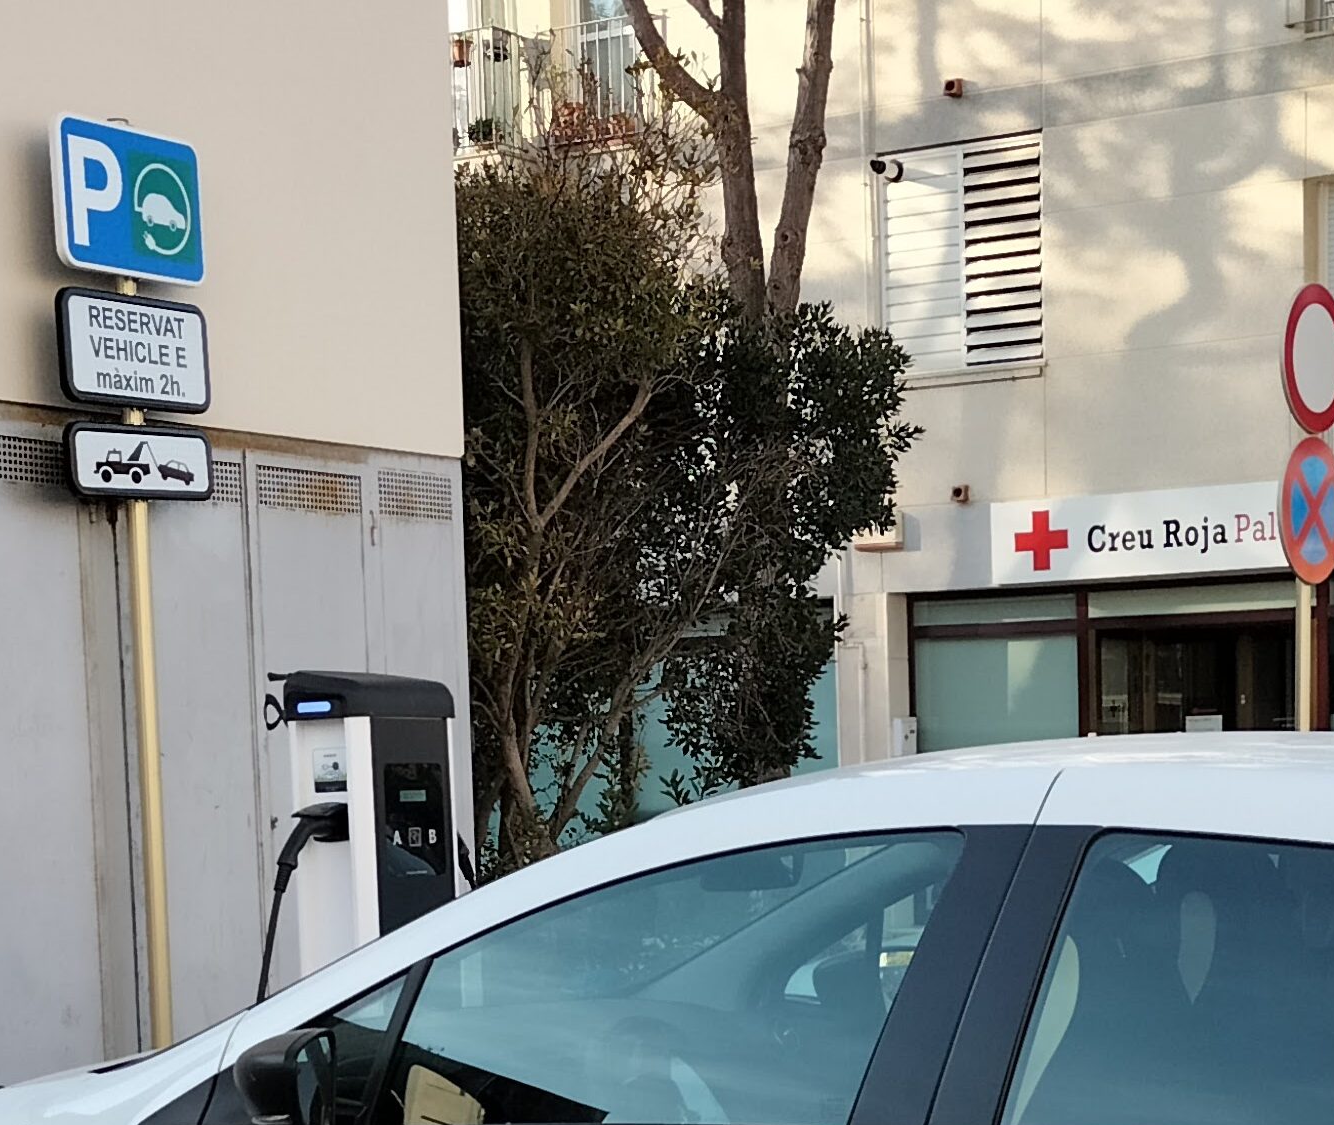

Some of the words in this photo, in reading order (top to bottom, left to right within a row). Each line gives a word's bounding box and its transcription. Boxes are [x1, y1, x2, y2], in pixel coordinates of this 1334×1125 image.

[66, 133, 123, 247] P
[88, 304, 185, 340] RESERVAT
[89, 335, 171, 367] VEHICLE
[177, 346, 187, 369] E
[96, 368, 154, 395] màxim
[158, 373, 186, 398] 2h.
[1087, 524, 1154, 553] Creu
[1162, 517, 1228, 555] Roja
[393, 830, 402, 846] A
[428, 828, 437, 844] B
